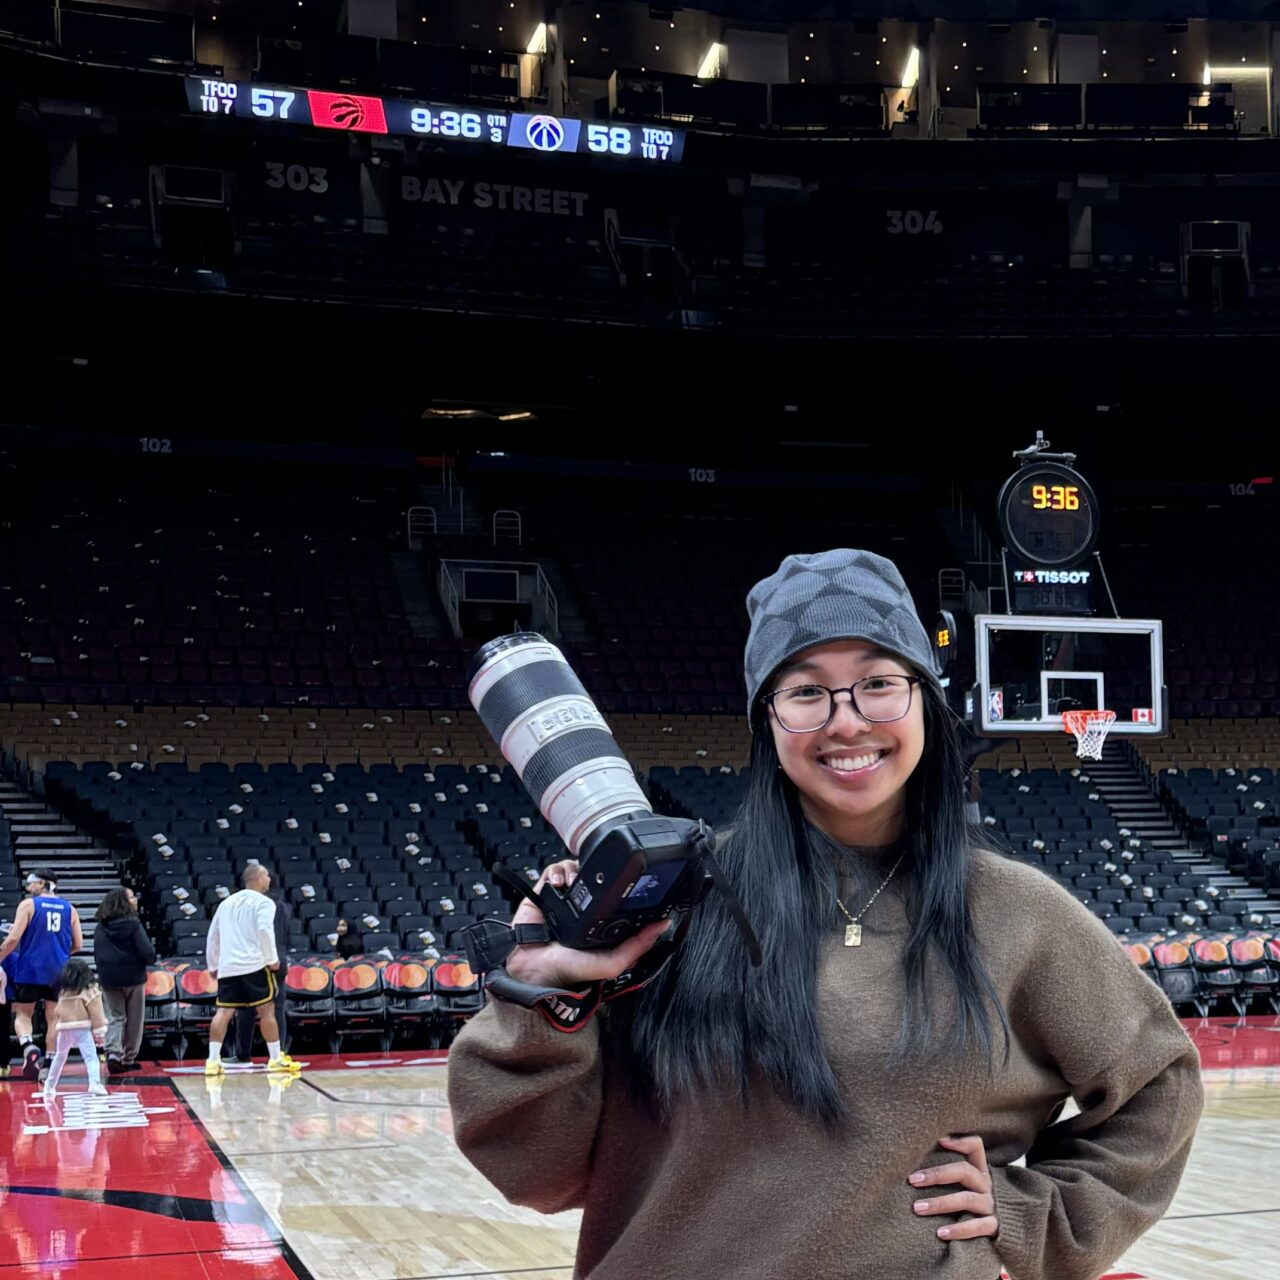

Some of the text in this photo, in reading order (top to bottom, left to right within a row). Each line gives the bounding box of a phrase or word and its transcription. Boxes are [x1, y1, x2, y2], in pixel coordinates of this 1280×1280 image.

[200, 96, 233, 114] TO 7
[252, 87, 295, 118] 57
[411, 108, 481, 138] 9:36
[487, 114, 506, 127] QTR
[490, 128, 502, 142] 3
[588, 125, 631, 154] 58
[641, 142, 669, 160] TO 7
[266, 163, 328, 194] 303
[401, 175, 589, 217] BAY STREET
[886, 210, 944, 234] 304
[139, 437, 172, 453] 102
[688, 467, 715, 483] 103
[1032, 485, 1079, 510] 9:36
[1229, 483, 1256, 496] 104
[1035, 570, 1090, 584] TISSOT
[47, 911, 61, 932] 13
